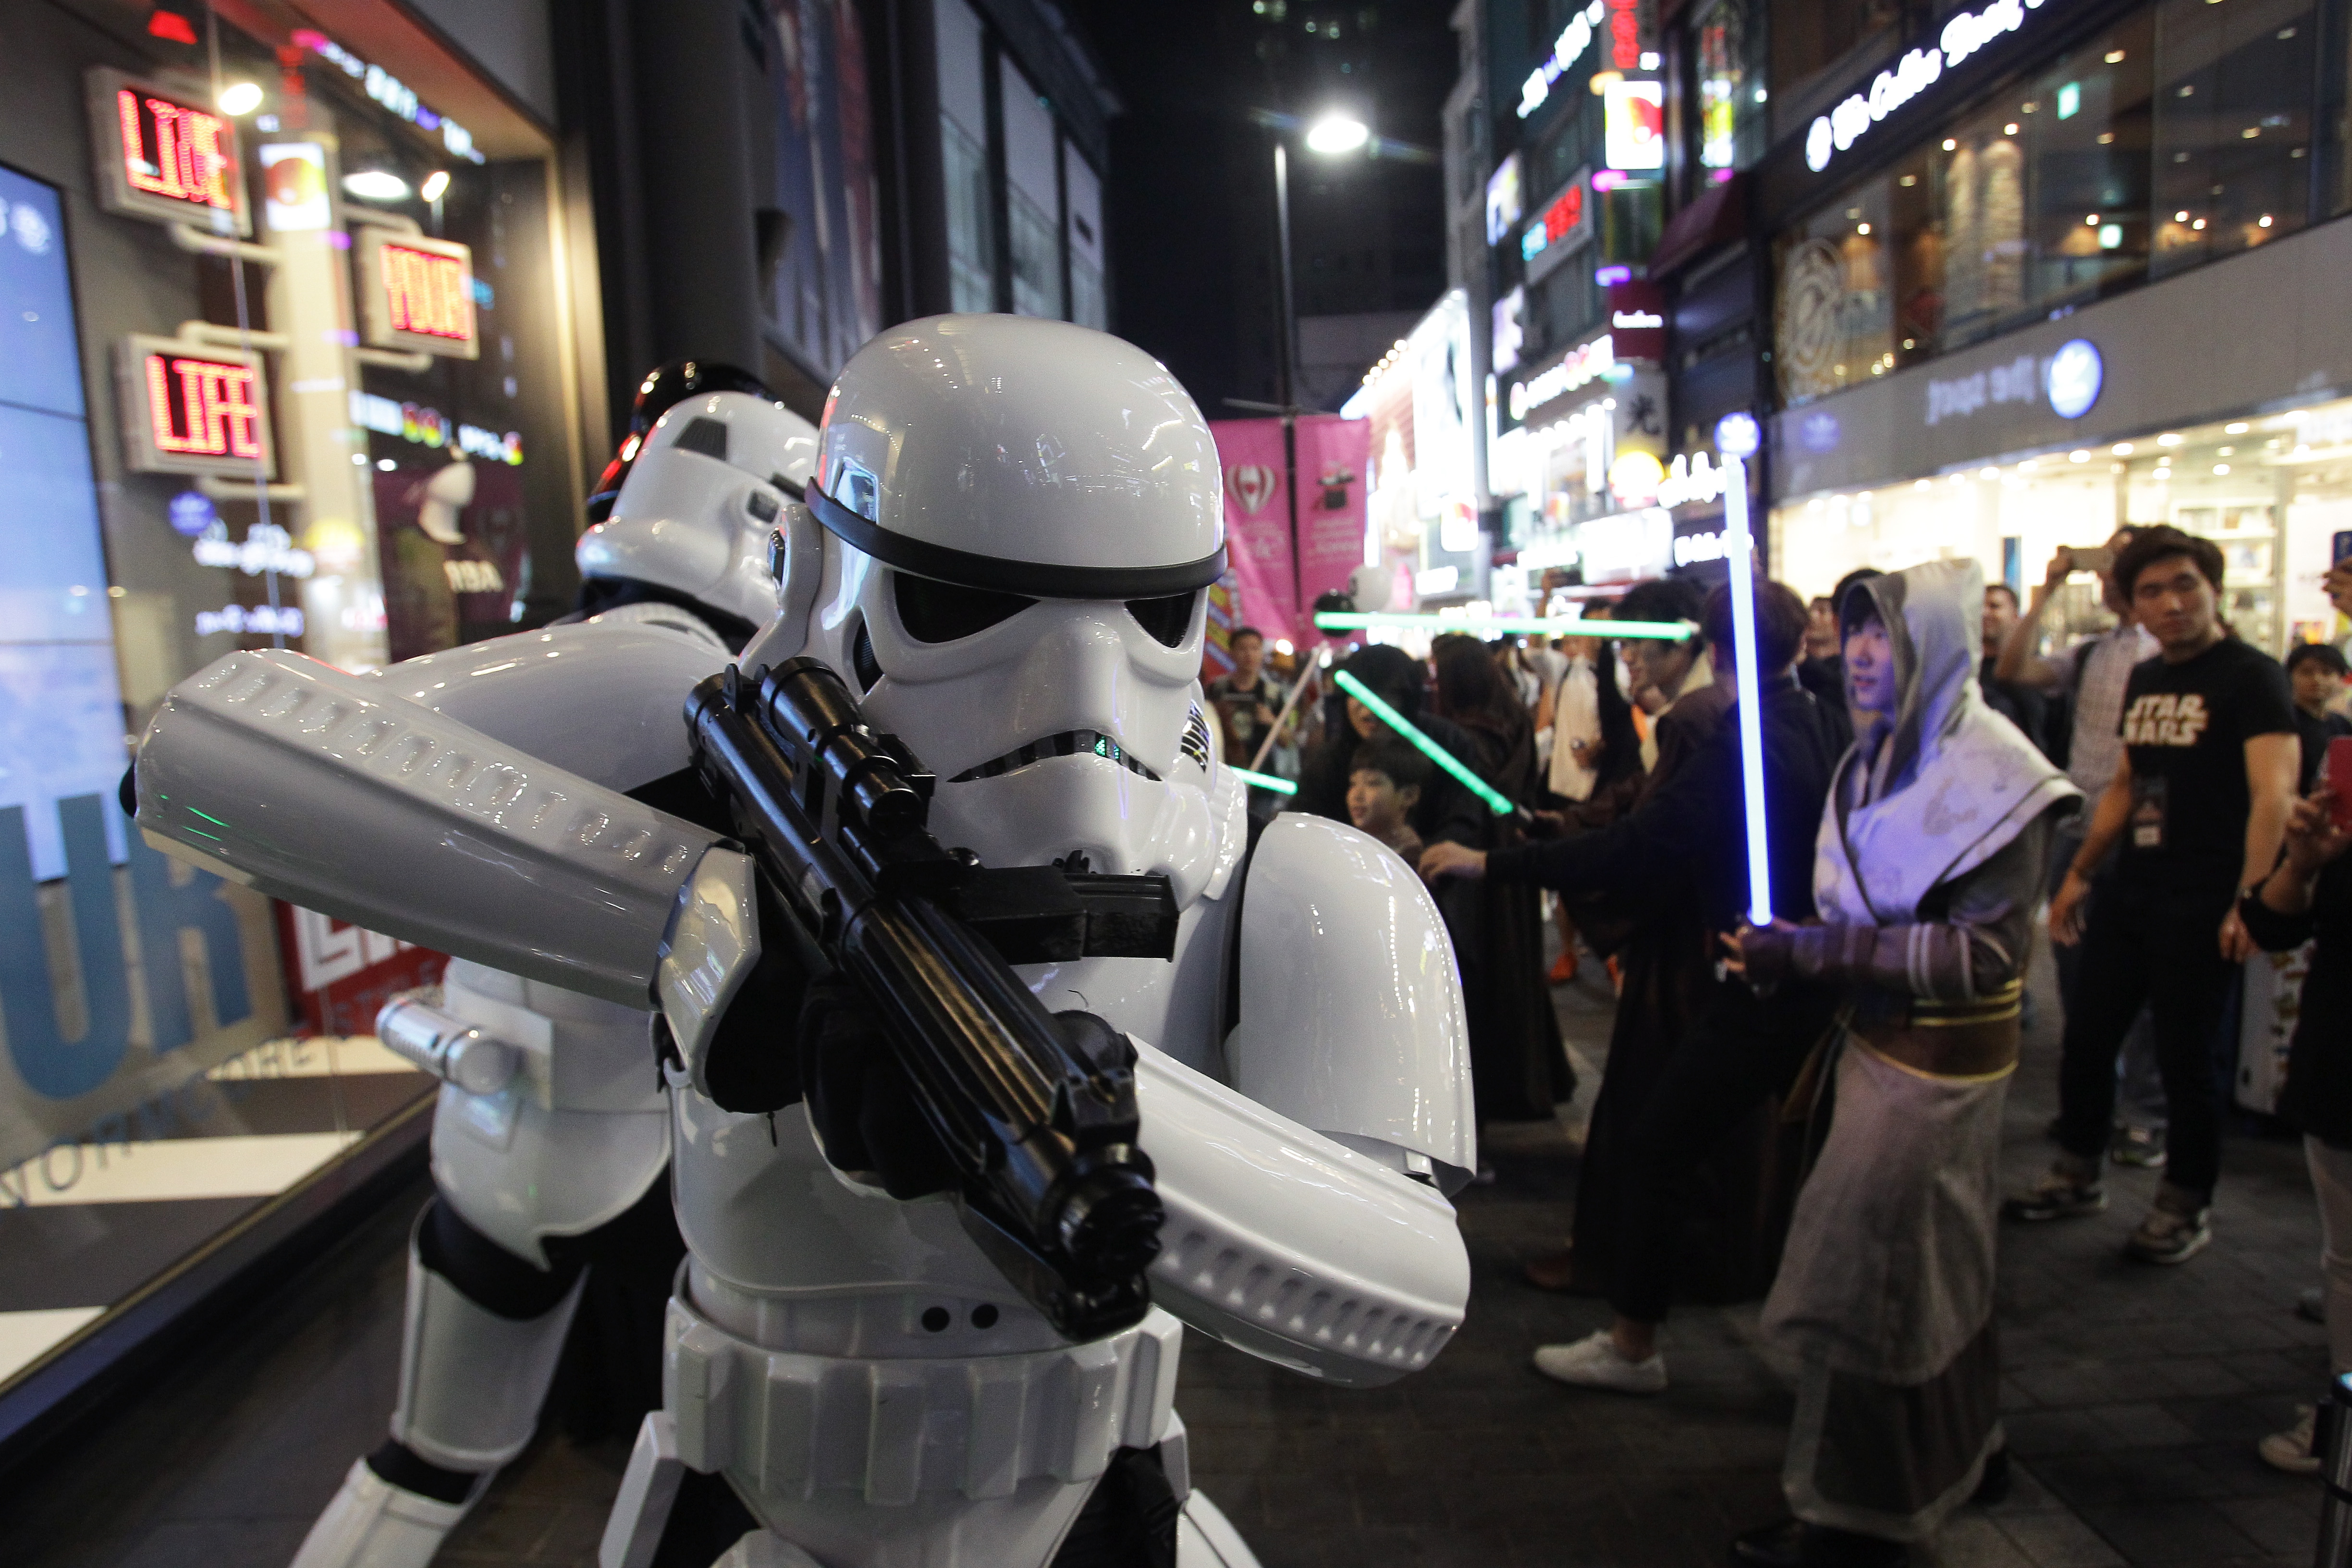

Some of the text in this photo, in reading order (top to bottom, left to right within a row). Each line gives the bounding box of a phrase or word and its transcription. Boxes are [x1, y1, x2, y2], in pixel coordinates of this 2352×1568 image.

[146, 355, 260, 457] LIFE
[2125, 693, 2209, 721] STAR
[2123, 719, 2208, 746] WARS
